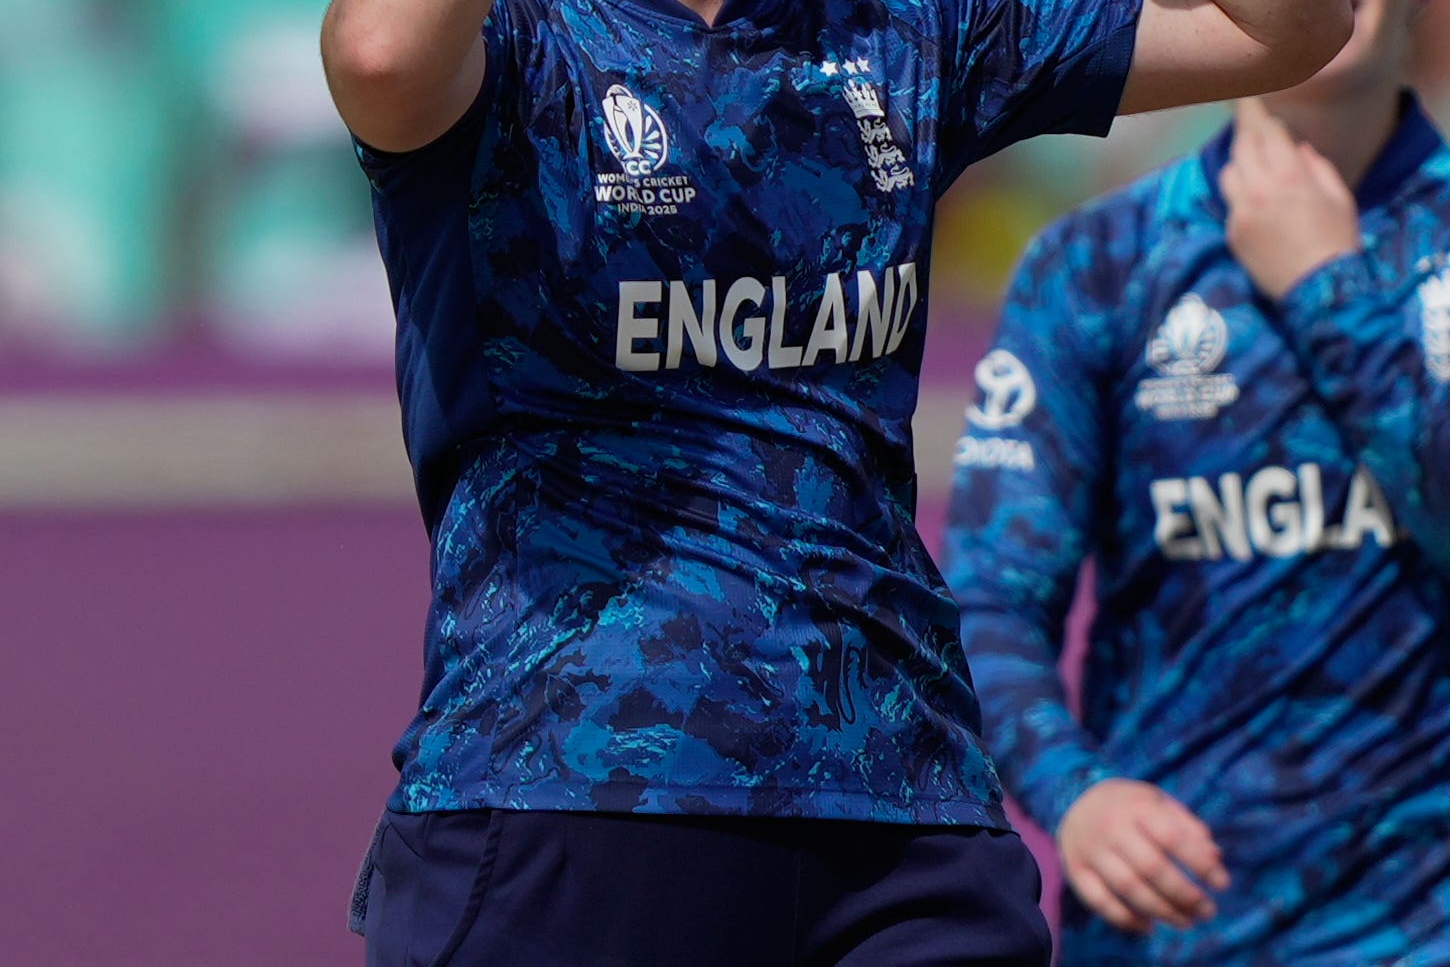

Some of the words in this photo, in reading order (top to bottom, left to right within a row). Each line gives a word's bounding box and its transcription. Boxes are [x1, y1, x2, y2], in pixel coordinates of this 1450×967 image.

[643, 176, 688, 188] CRICKET
[594, 185, 656, 204] WORLD
[659, 187, 697, 204] CUP
[618, 202, 646, 214] INDIA
[647, 204, 678, 215] 2025
[615, 262, 917, 371] ENGLAND
[1150, 462, 1396, 563] ENGLA
